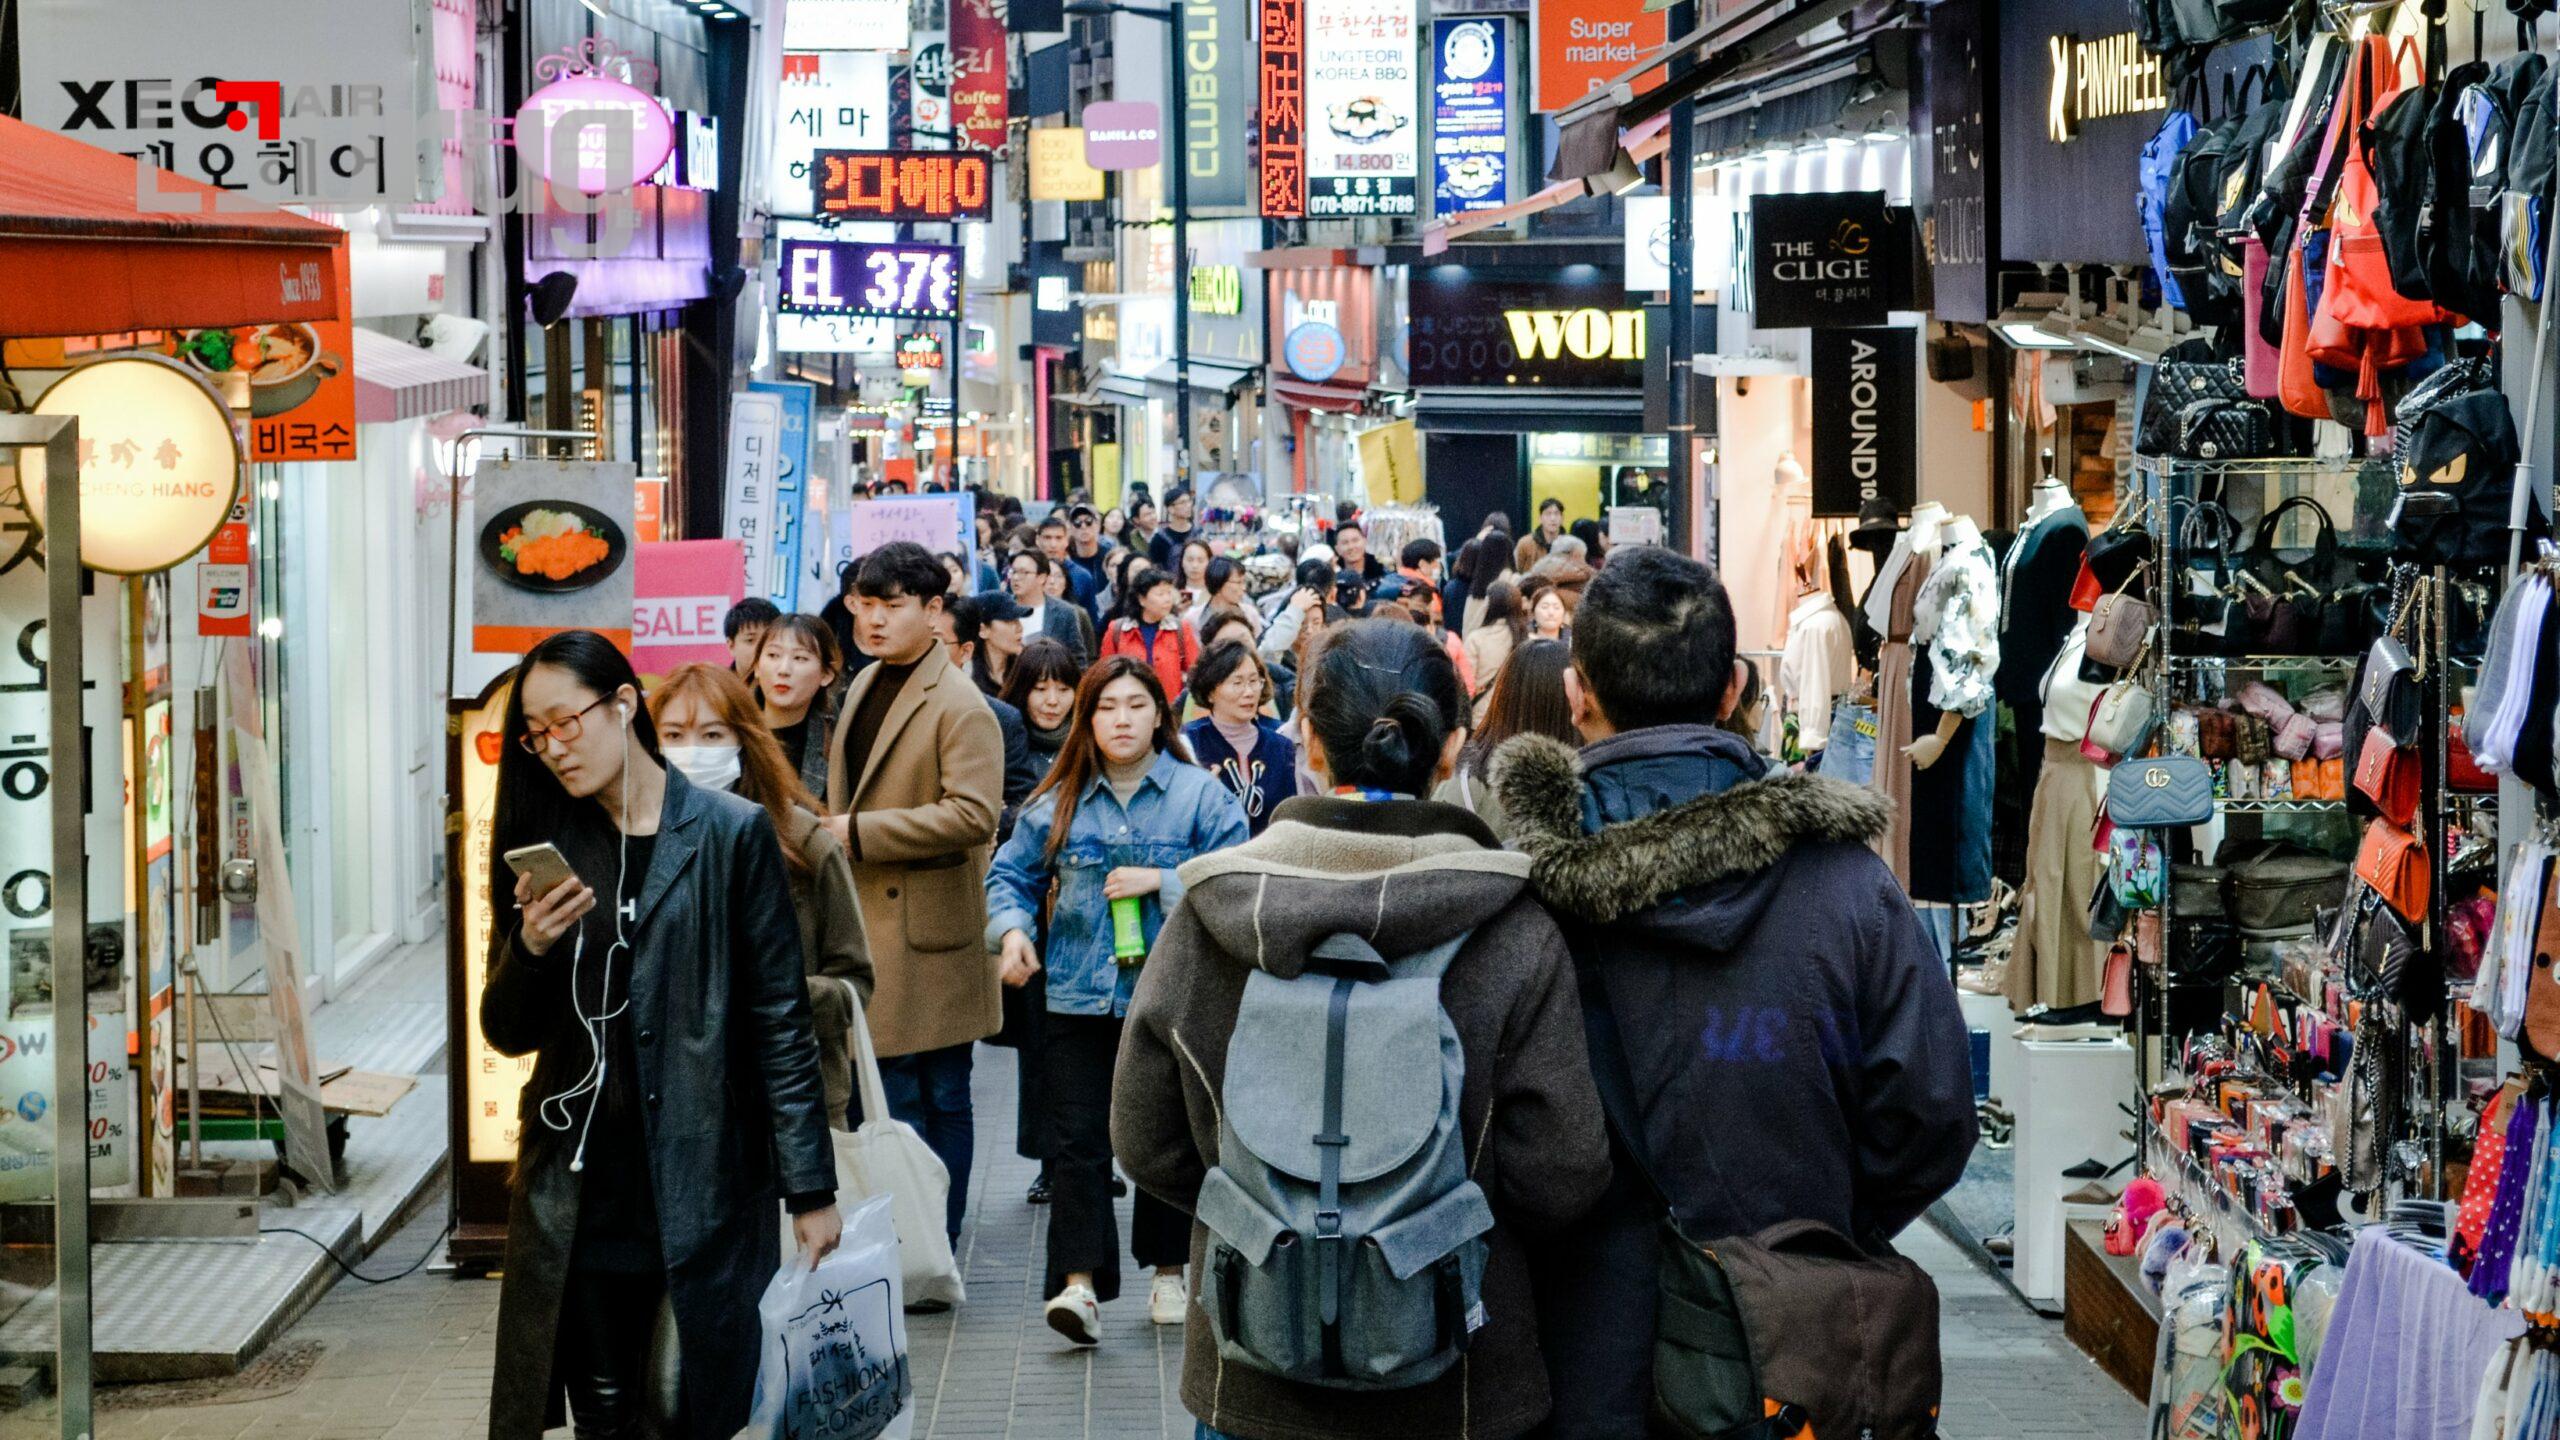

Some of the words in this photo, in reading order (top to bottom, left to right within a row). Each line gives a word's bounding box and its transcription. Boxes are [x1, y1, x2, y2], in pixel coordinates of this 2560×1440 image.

[1569, 18, 1634, 39] Super
[1566, 43, 1637, 62] market
[1315, 67, 1370, 80] KOREA
[1375, 67, 1408, 80] BBQ
[953, 90, 1001, 105] Coffee
[965, 115, 1003, 130] Cake
[1772, 241, 1815, 257] THE
[1772, 259, 1871, 281] CLIGE
[152, 482, 216, 497] HIANG
[633, 605, 717, 637] SALE
[797, 1359, 890, 1414] FASHION
